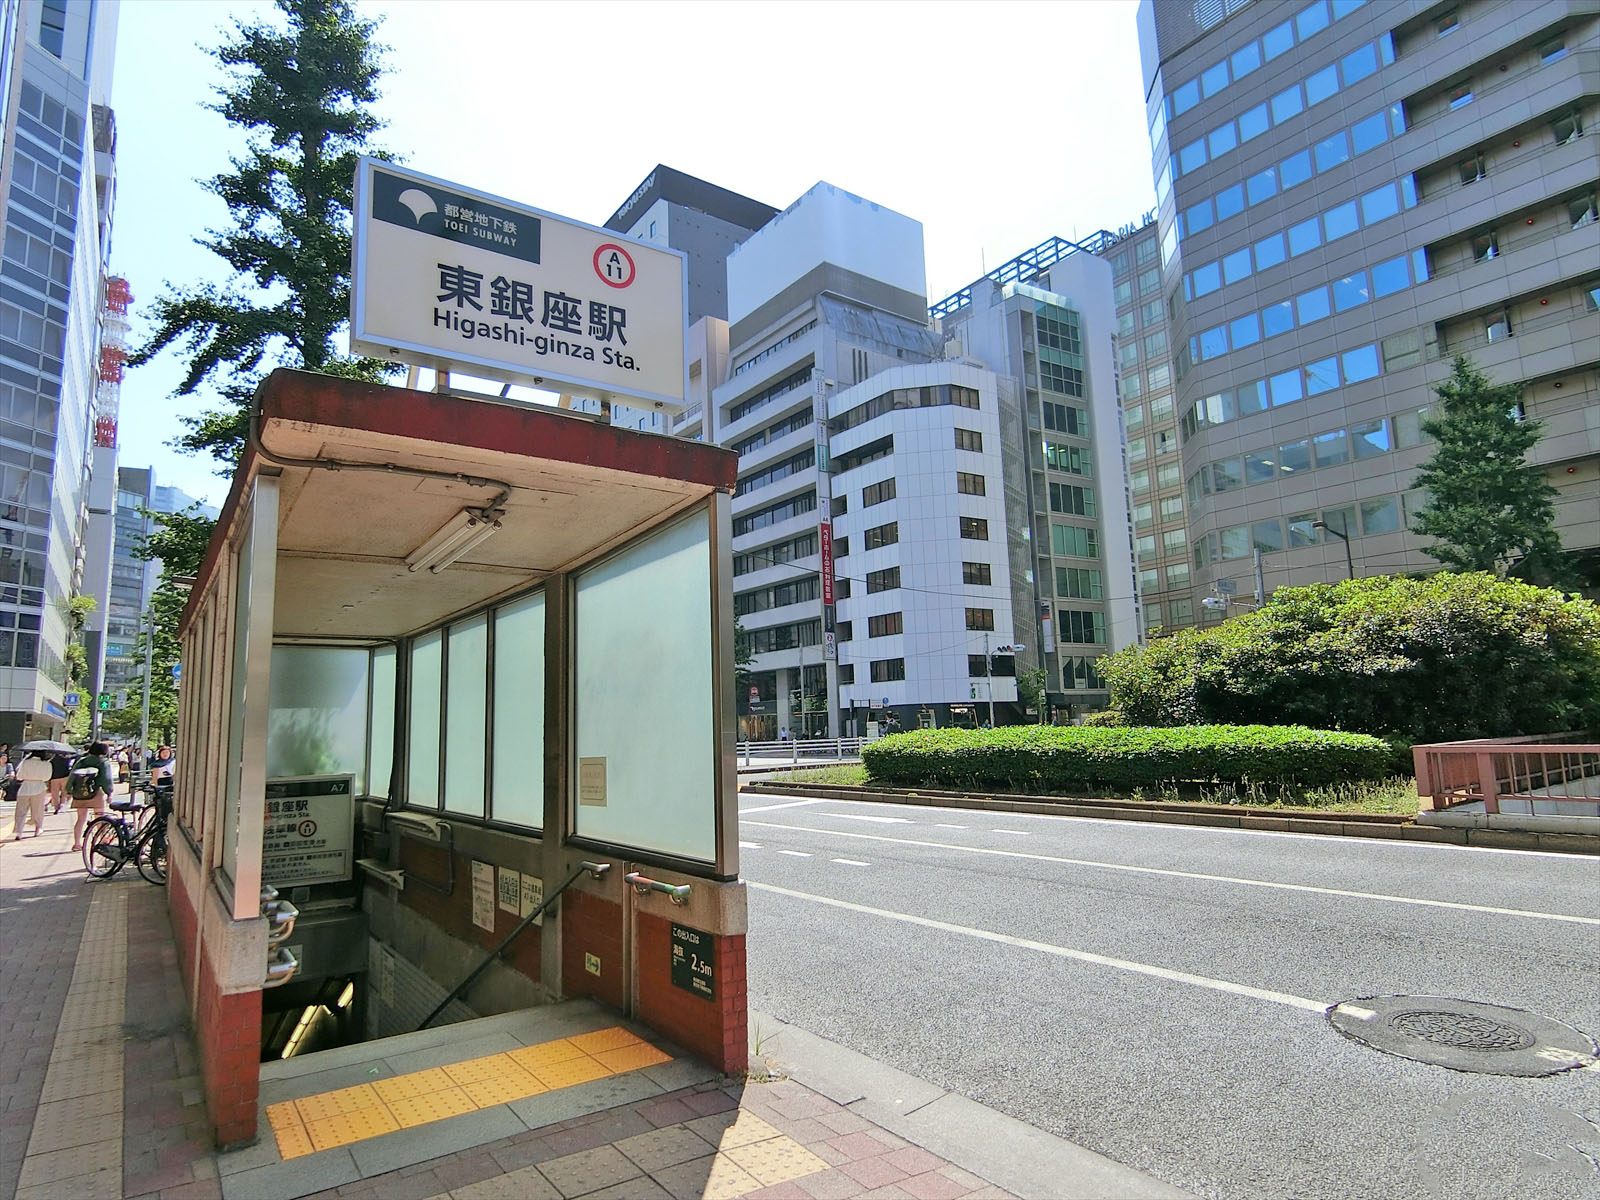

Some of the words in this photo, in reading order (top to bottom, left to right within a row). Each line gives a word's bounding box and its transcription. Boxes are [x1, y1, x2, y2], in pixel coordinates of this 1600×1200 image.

[444, 203, 518, 235] 都営地下鉄
[444, 219, 468, 233] TOEI
[473, 227, 517, 247] SUBWAY
[609, 252, 620, 265] A
[606, 263, 622, 280] 11
[436, 262, 628, 346] 東銀座駅
[433, 307, 595, 361] Higashi-ginza
[602, 346, 641, 371] Sta.
[330, 783, 345, 792] A7
[691, 954, 712, 976] 2.5m
